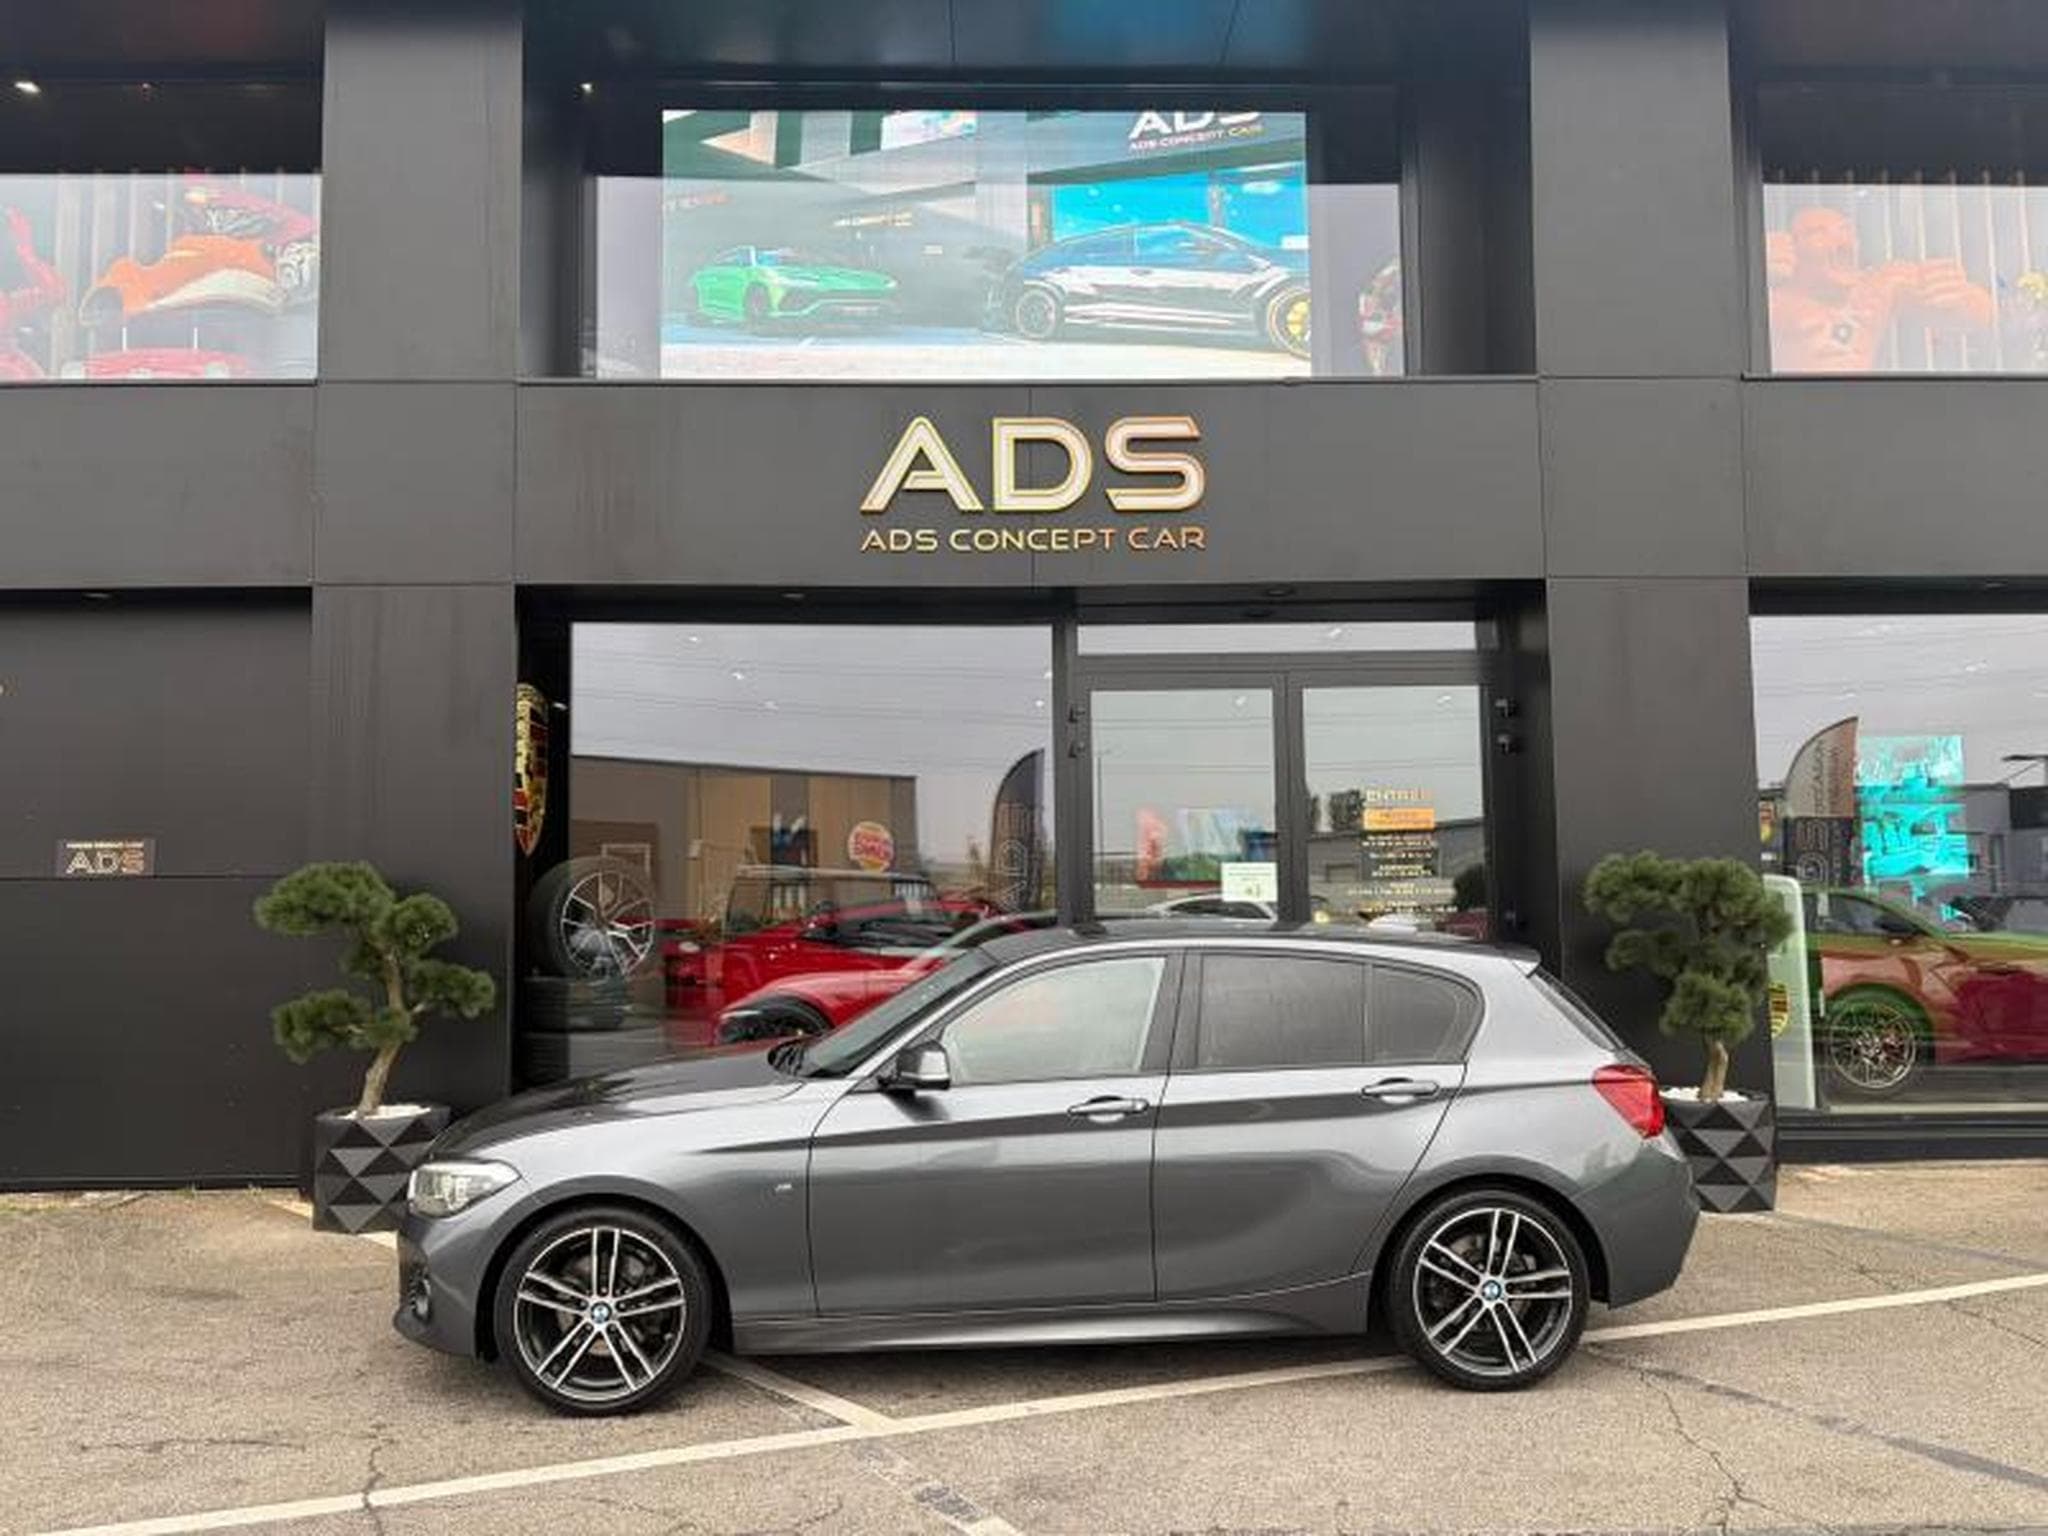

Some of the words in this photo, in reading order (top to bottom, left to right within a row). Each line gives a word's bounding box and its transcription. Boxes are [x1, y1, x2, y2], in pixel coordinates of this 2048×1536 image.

[859, 415, 1205, 511] ADS
[860, 528, 938, 551] ADS
[949, 528, 1116, 551] CONCEPT
[1127, 527, 1206, 550] CAR
[65, 850, 144, 875] ADS
